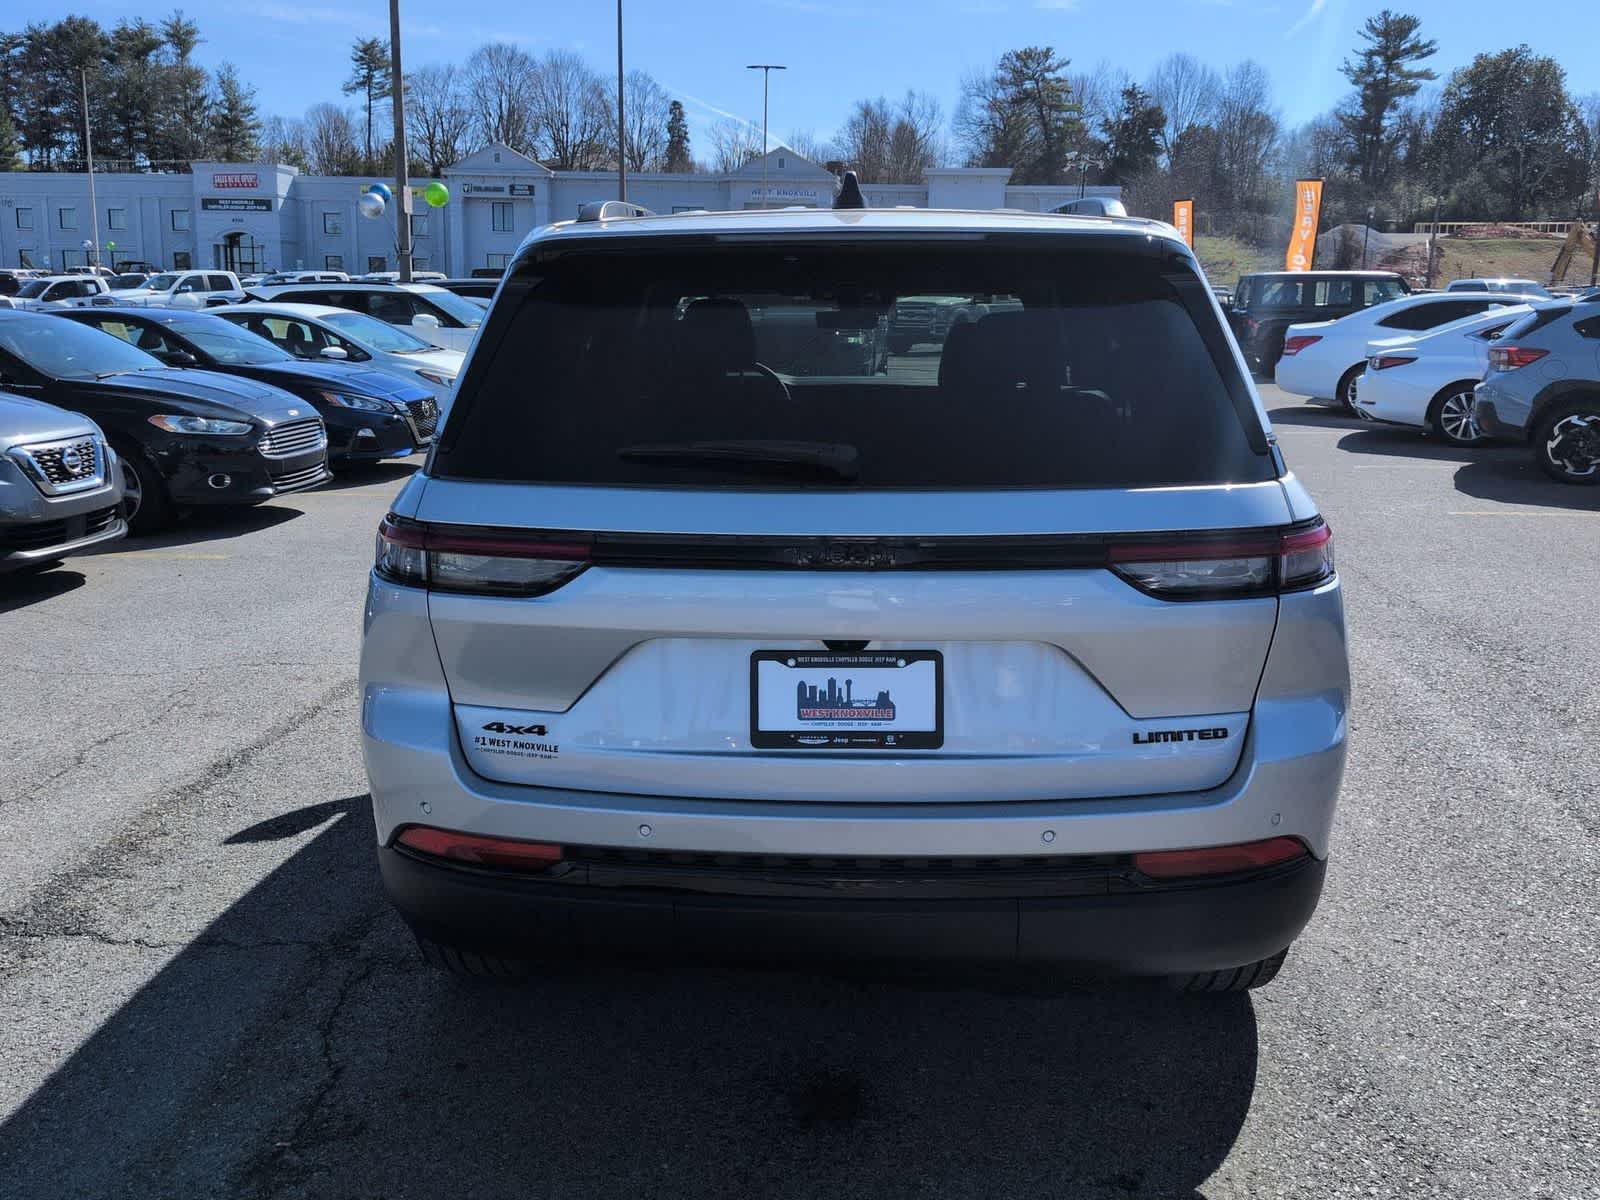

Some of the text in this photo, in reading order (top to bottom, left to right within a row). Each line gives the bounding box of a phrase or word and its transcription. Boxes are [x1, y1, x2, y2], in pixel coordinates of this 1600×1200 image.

[801, 708, 893, 718] WEST KNOXVILLE
[1132, 727, 1229, 745] LIMITED
[488, 737, 511, 748] WEST
[513, 740, 560, 753] KNOXVILLE
